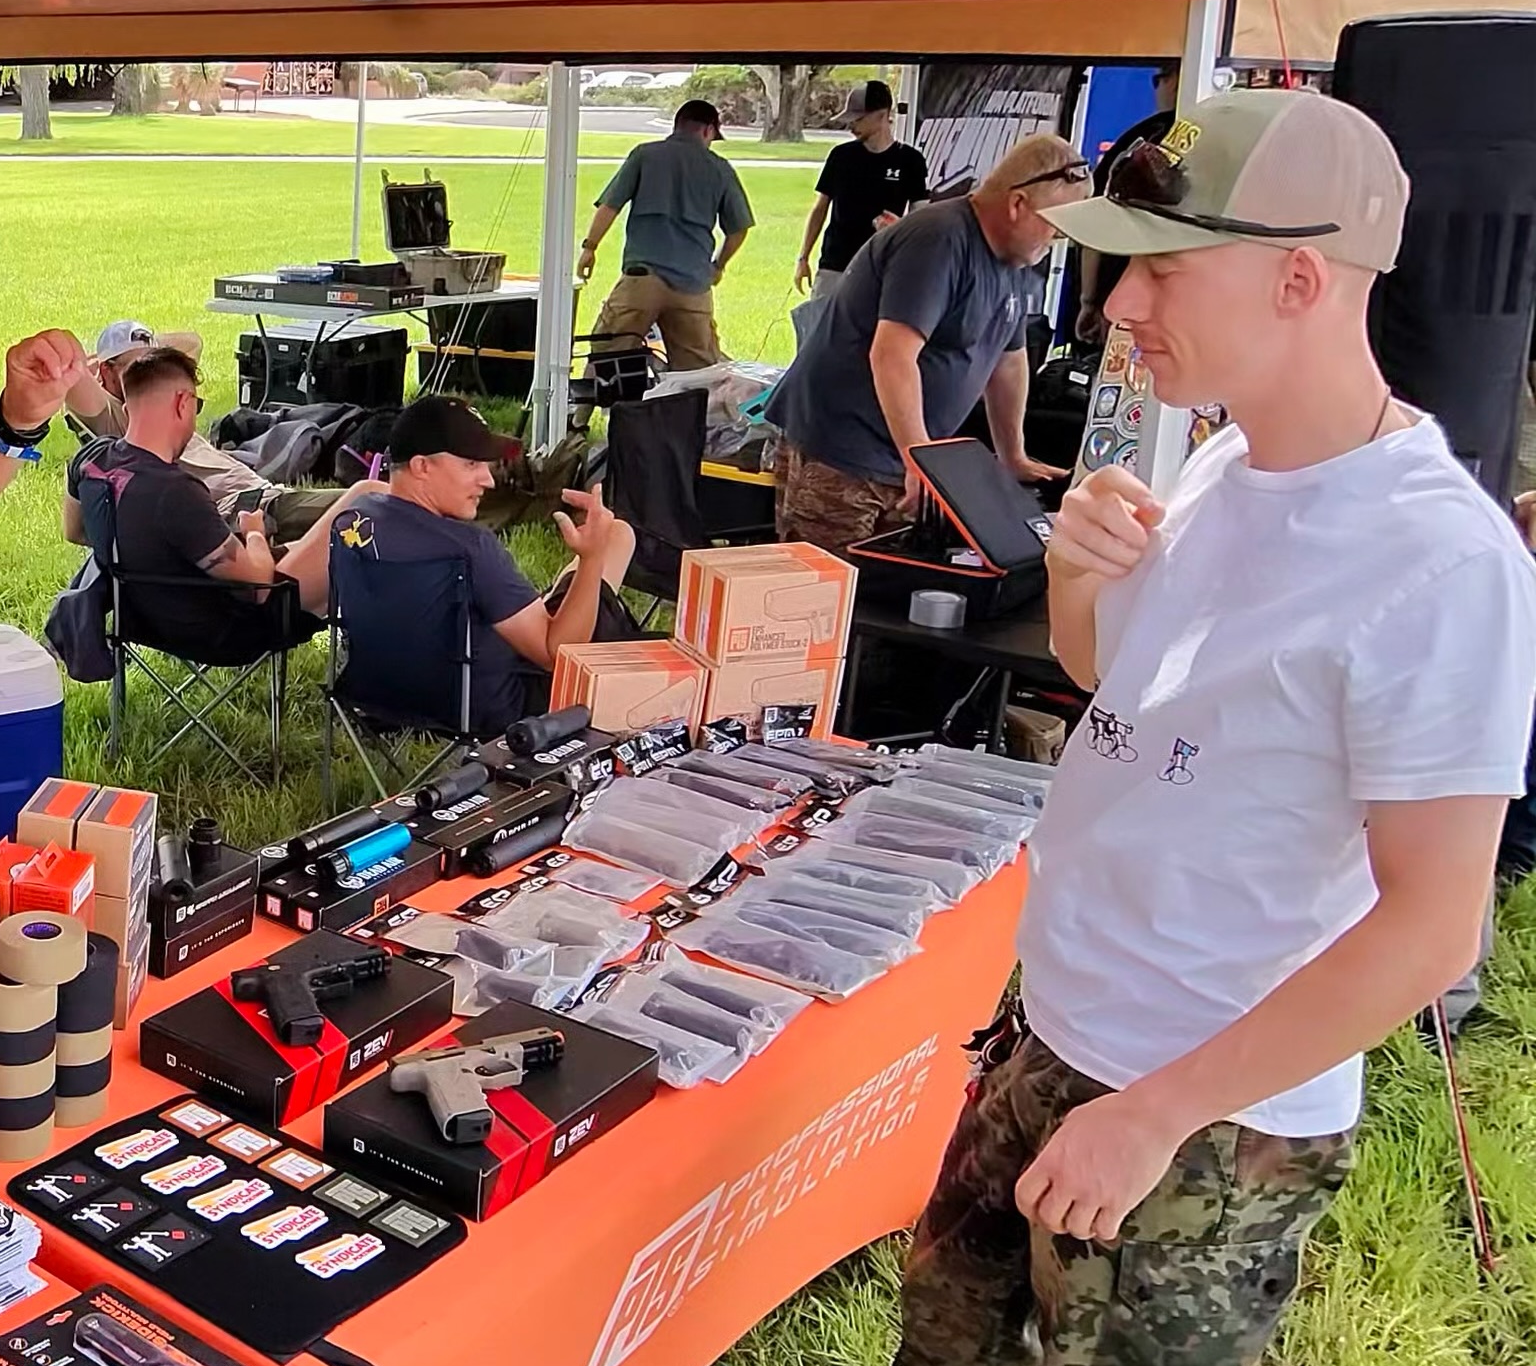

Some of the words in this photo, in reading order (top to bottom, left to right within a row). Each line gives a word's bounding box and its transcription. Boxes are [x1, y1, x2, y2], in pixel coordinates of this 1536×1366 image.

[358, 863, 382, 881] DEAD
[380, 856, 405, 873] AIR
[363, 1031, 390, 1056] ZEV
[568, 1114, 596, 1142] ZEV
[721, 1033, 939, 1212] PROFESSIONAL
[114, 1130, 173, 1166] SYNDICATE
[712, 1087, 906, 1246] TRAINING
[163, 1156, 220, 1192] SYNDICATE
[207, 1180, 266, 1218] SYNDICATE
[687, 1100, 917, 1293] SIMULATION
[261, 1207, 320, 1246] SYNDICATE
[317, 1236, 376, 1275] SYNDICATE
[90, 1295, 169, 1348] SIDEKICK
